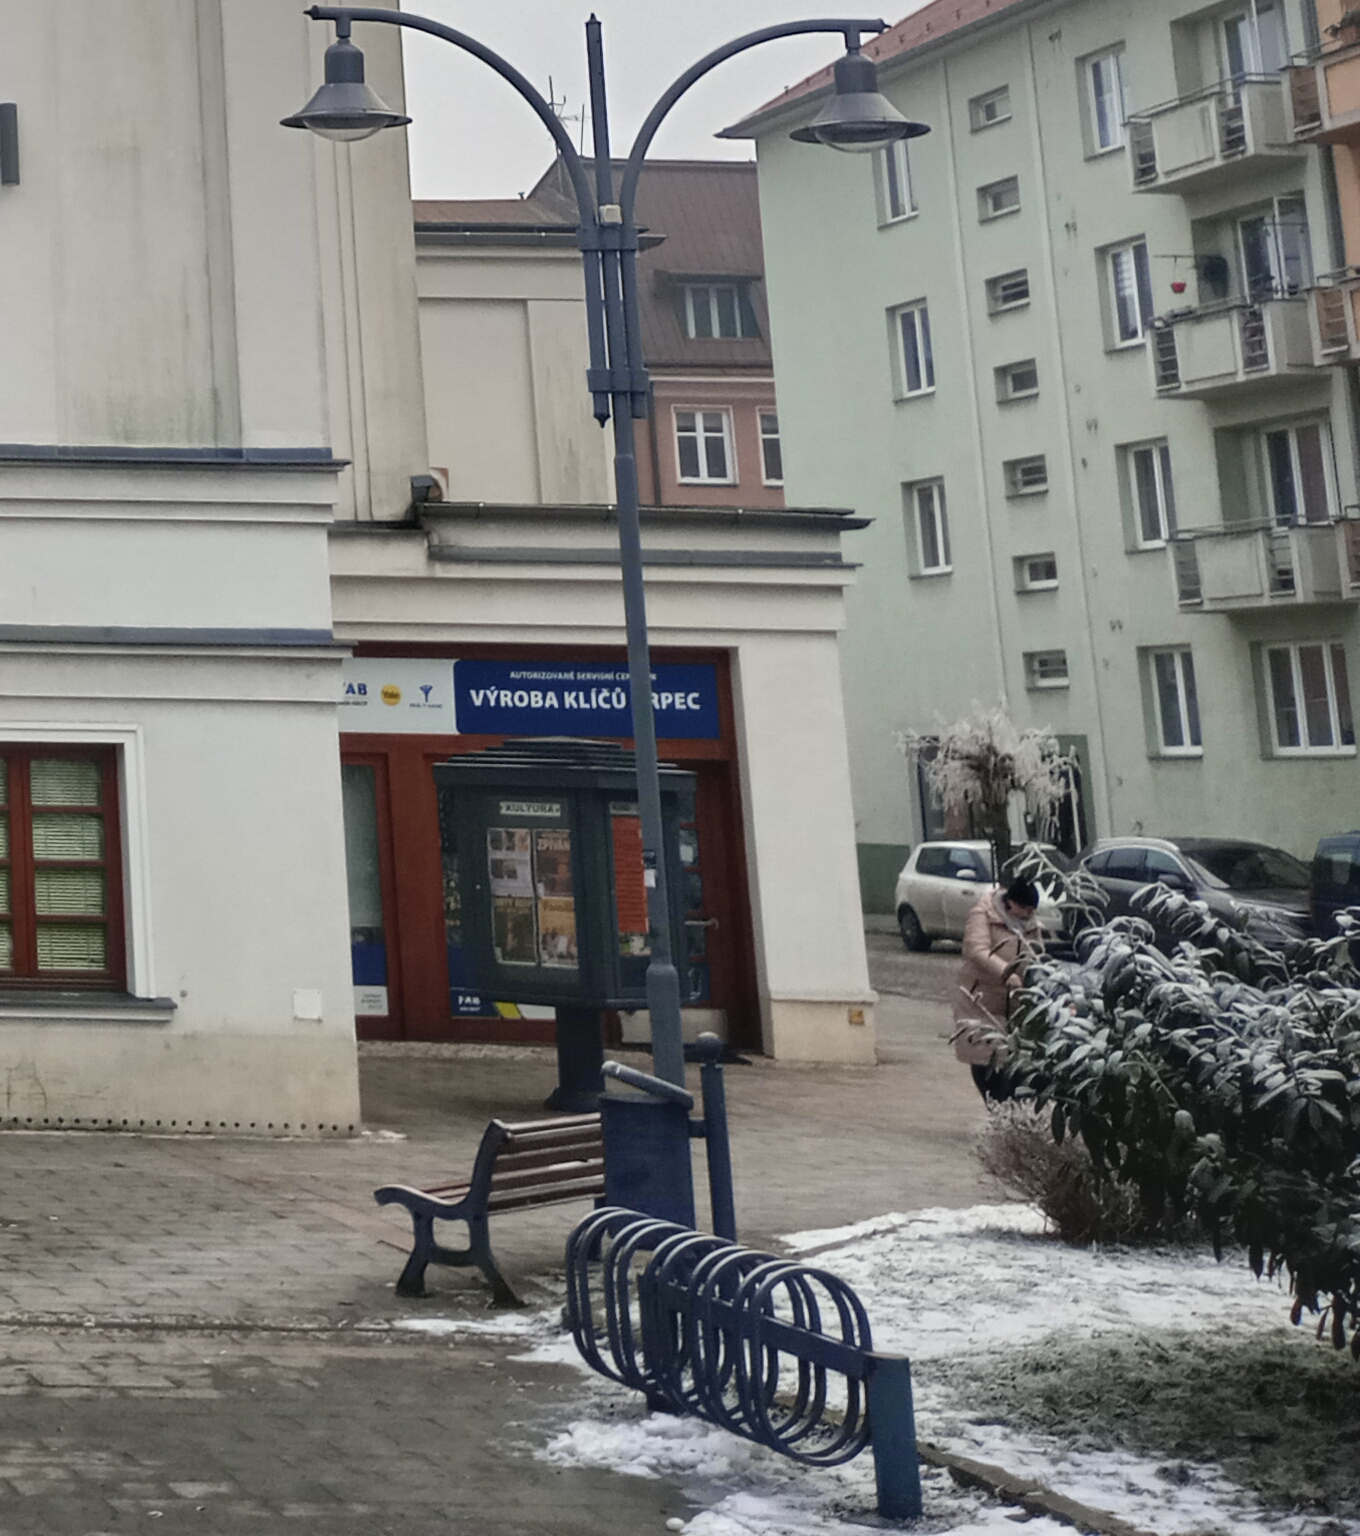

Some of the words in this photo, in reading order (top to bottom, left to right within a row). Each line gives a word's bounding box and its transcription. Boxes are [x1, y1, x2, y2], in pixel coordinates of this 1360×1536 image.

[343, 682, 368, 696] AB
[469, 685, 559, 709] VÝROBA
[564, 686, 627, 710] KLÍČŮ
[650, 692, 701, 710] RPEC
